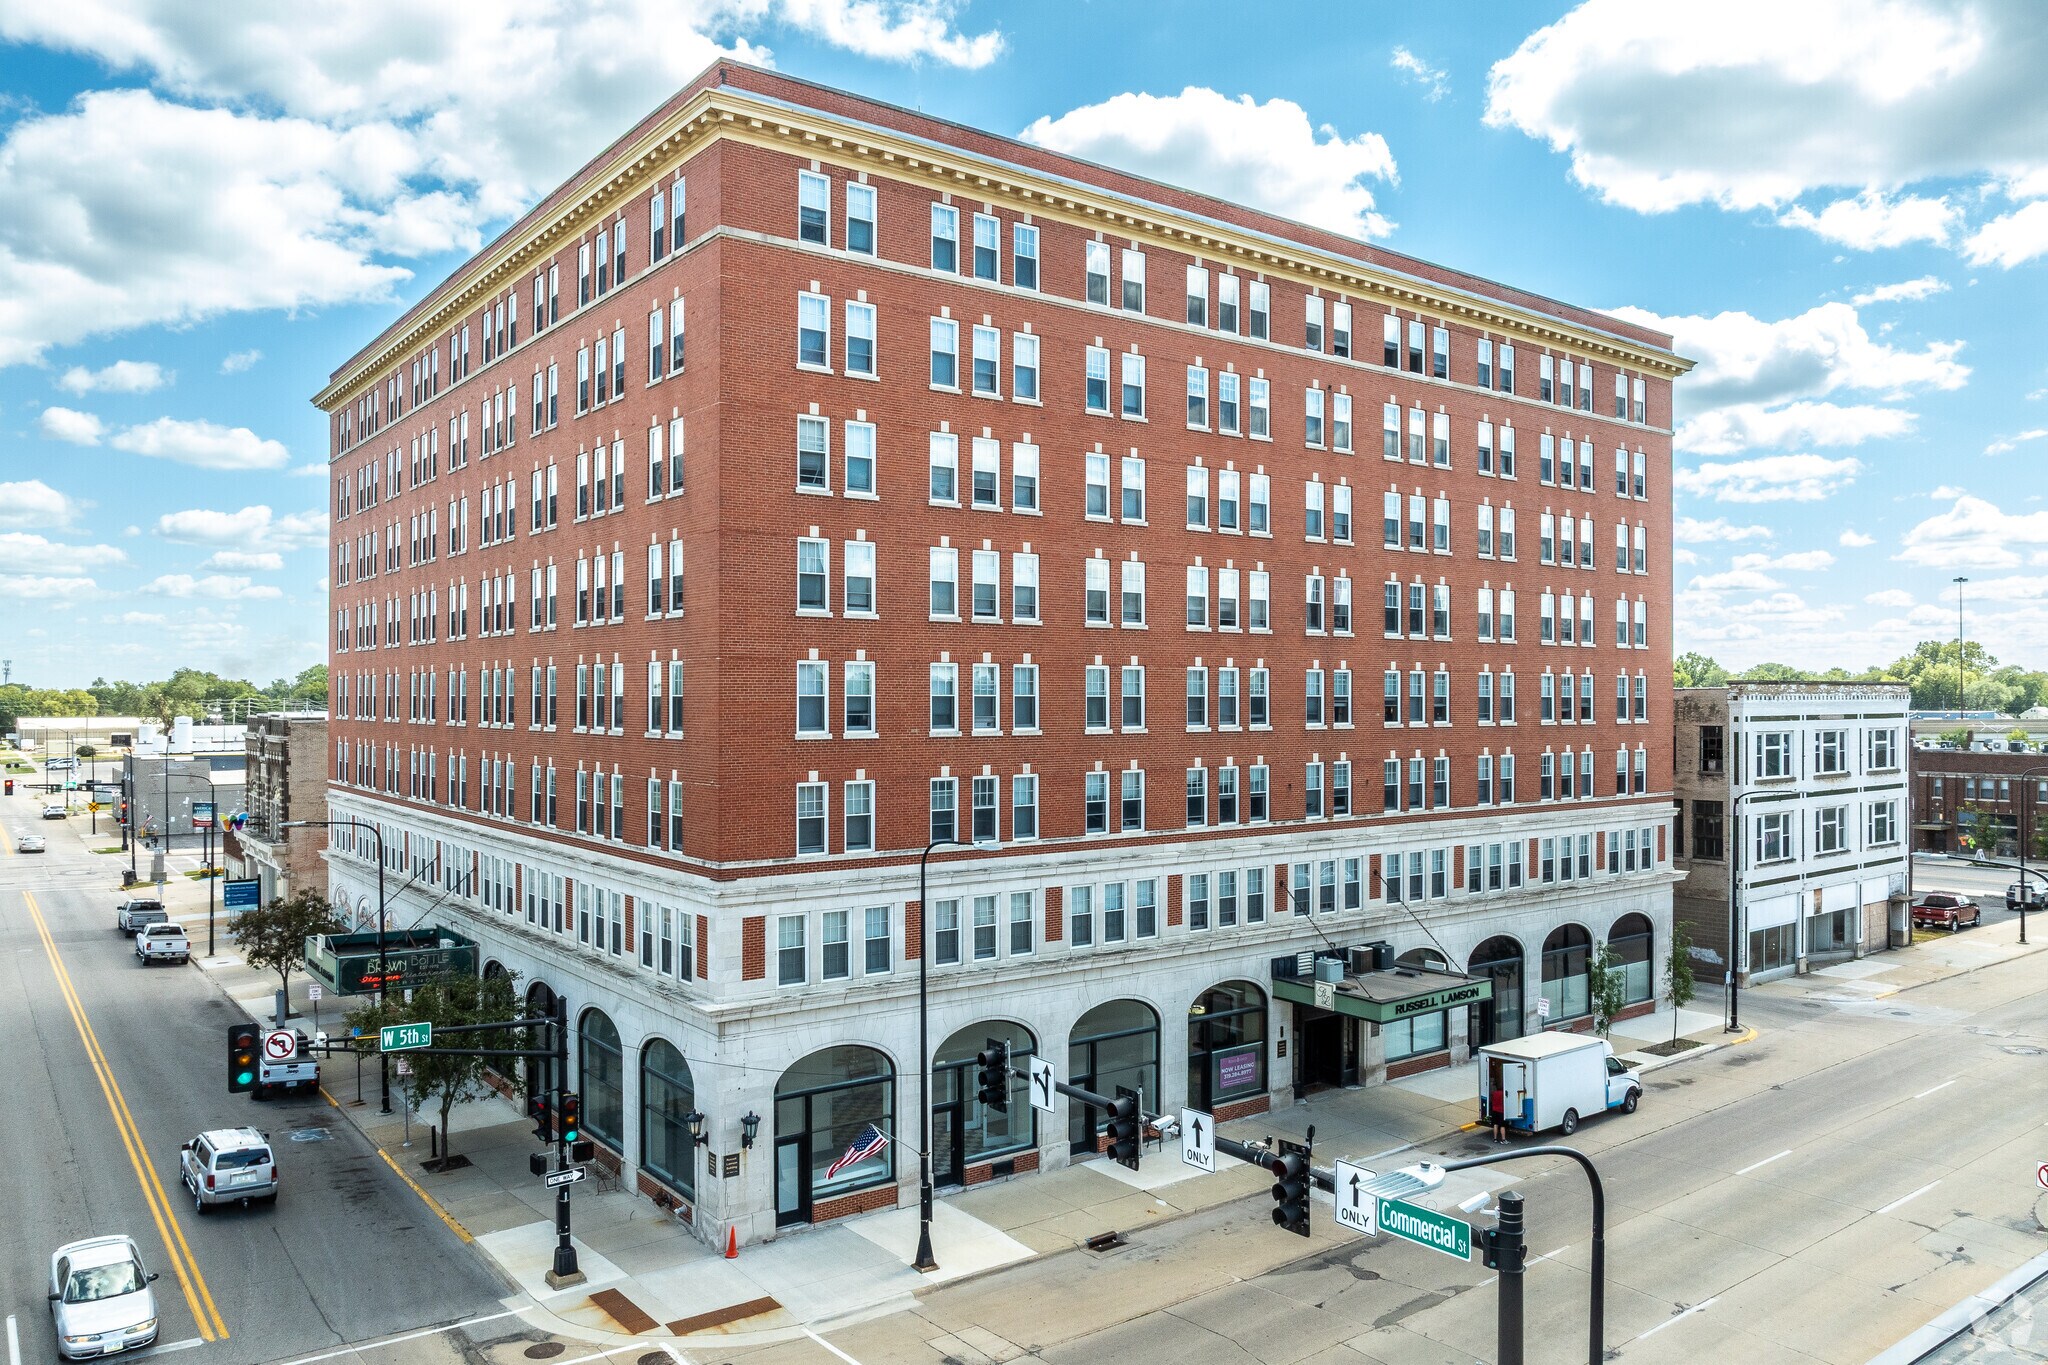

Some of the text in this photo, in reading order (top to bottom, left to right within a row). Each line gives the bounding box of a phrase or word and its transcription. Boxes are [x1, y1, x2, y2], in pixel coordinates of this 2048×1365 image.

[1395, 987, 1480, 1015] RUSSELL LAMSON
[383, 1028, 428, 1047] W 5th St
[1234, 1062, 1255, 1071] LEASING
[1187, 1149, 1210, 1166] ONLY
[550, 1176, 560, 1184] ONE
[1341, 1207, 1370, 1228] ONLY
[1381, 1201, 1468, 1254] Commercial St
